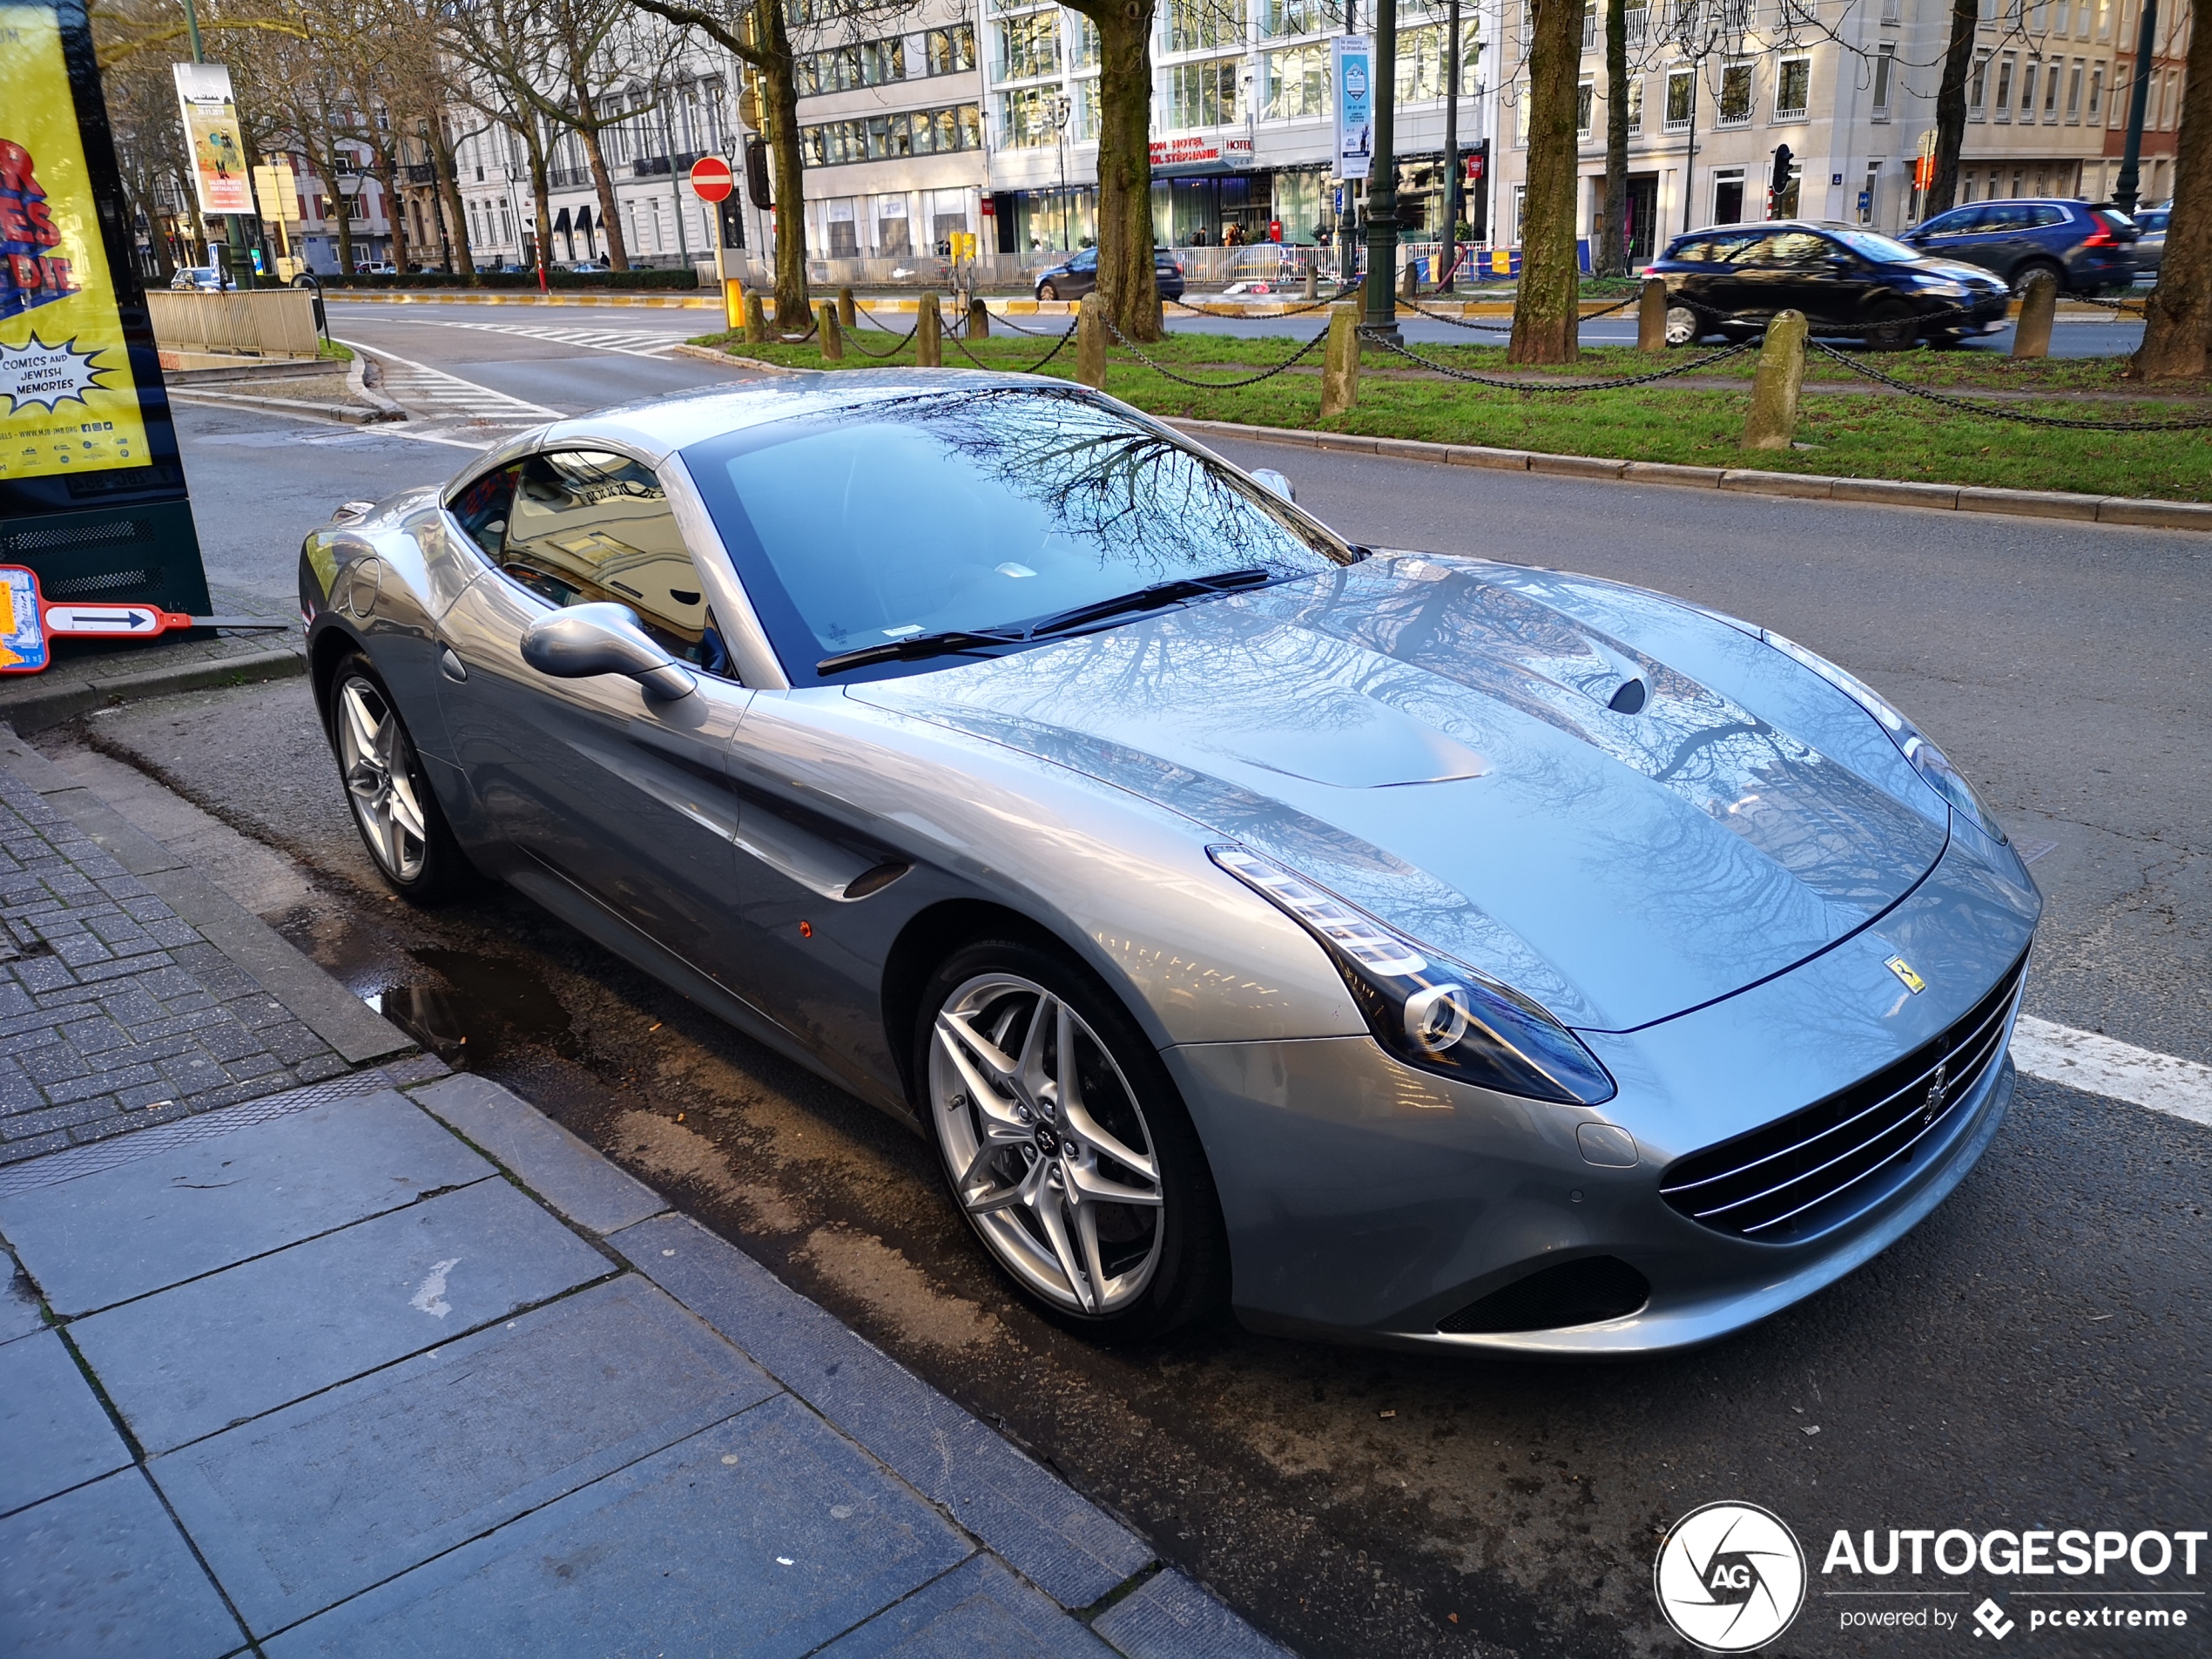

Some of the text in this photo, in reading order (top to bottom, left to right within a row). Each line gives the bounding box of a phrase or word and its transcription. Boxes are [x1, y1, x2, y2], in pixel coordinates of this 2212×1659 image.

[1172, 137, 1204, 150] HOTEL
[1226, 140, 1252, 151] HOTEL
[1164, 147, 1220, 164] STÉPHANIE
[8, 253, 82, 293] DIE
[3, 354, 67, 370] COMICS AND
[21, 368, 62, 381] JEWISH
[17, 379, 74, 395] MEMORIES
